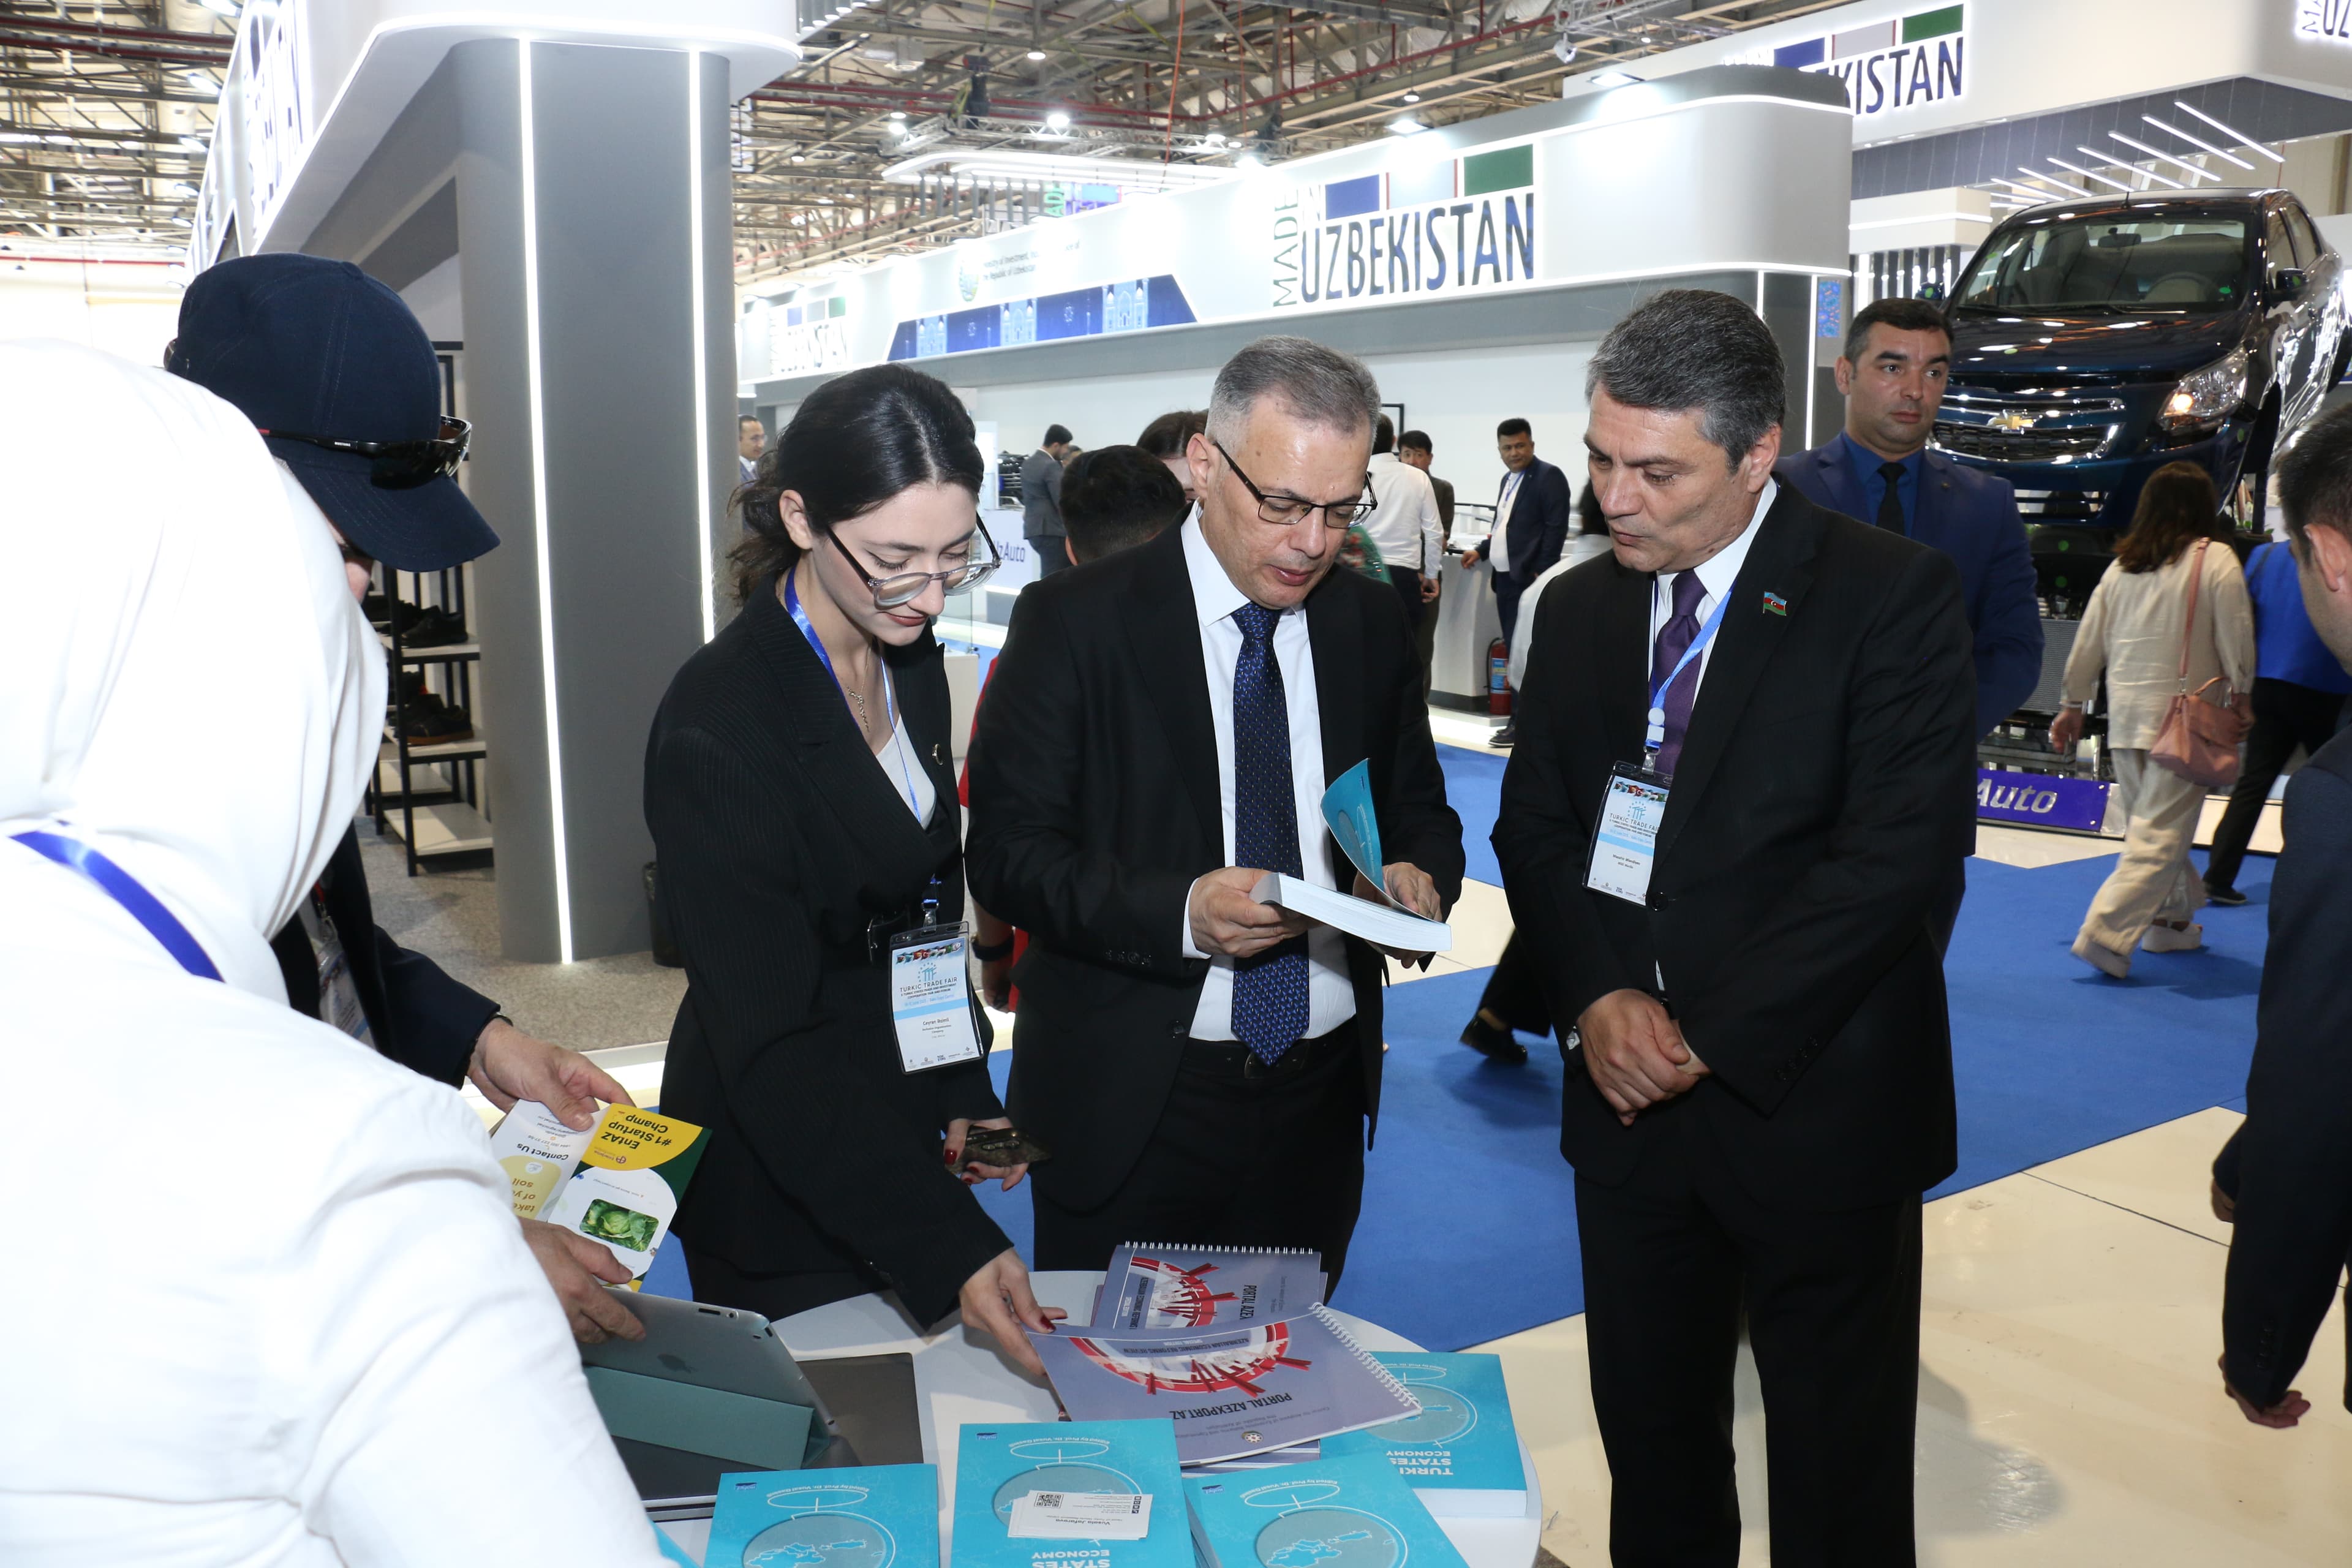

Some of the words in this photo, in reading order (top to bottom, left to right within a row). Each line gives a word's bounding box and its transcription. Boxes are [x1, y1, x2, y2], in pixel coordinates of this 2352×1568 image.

[1273, 187, 1299, 307] MADE
[1301, 192, 1534, 304] UZBEKISTAN
[997, 541, 1026, 563] zAuto
[1977, 778, 2058, 814] Auto
[1610, 813, 1629, 823] TURKIC
[1630, 819, 1648, 829] TRADE
[900, 984, 922, 993] TURKIC
[924, 979, 943, 988] TRADE
[608, 1121, 655, 1142] Startup
[625, 1114, 669, 1133] Champ
[517, 1143, 530, 1153] Us
[601, 1132, 641, 1150] EntAZ
[655, 1136, 672, 1147] #1
[531, 1148, 569, 1161] Contact
[1242, 1284, 1257, 1305] PORTAL
[1247, 1393, 1292, 1409] PORTAL
[1169, 1401, 1248, 1420] AZEXPORT.AZ
[1031, 1549, 1110, 1559] ECONOMY
[1031, 1559, 1111, 1568] STATES
